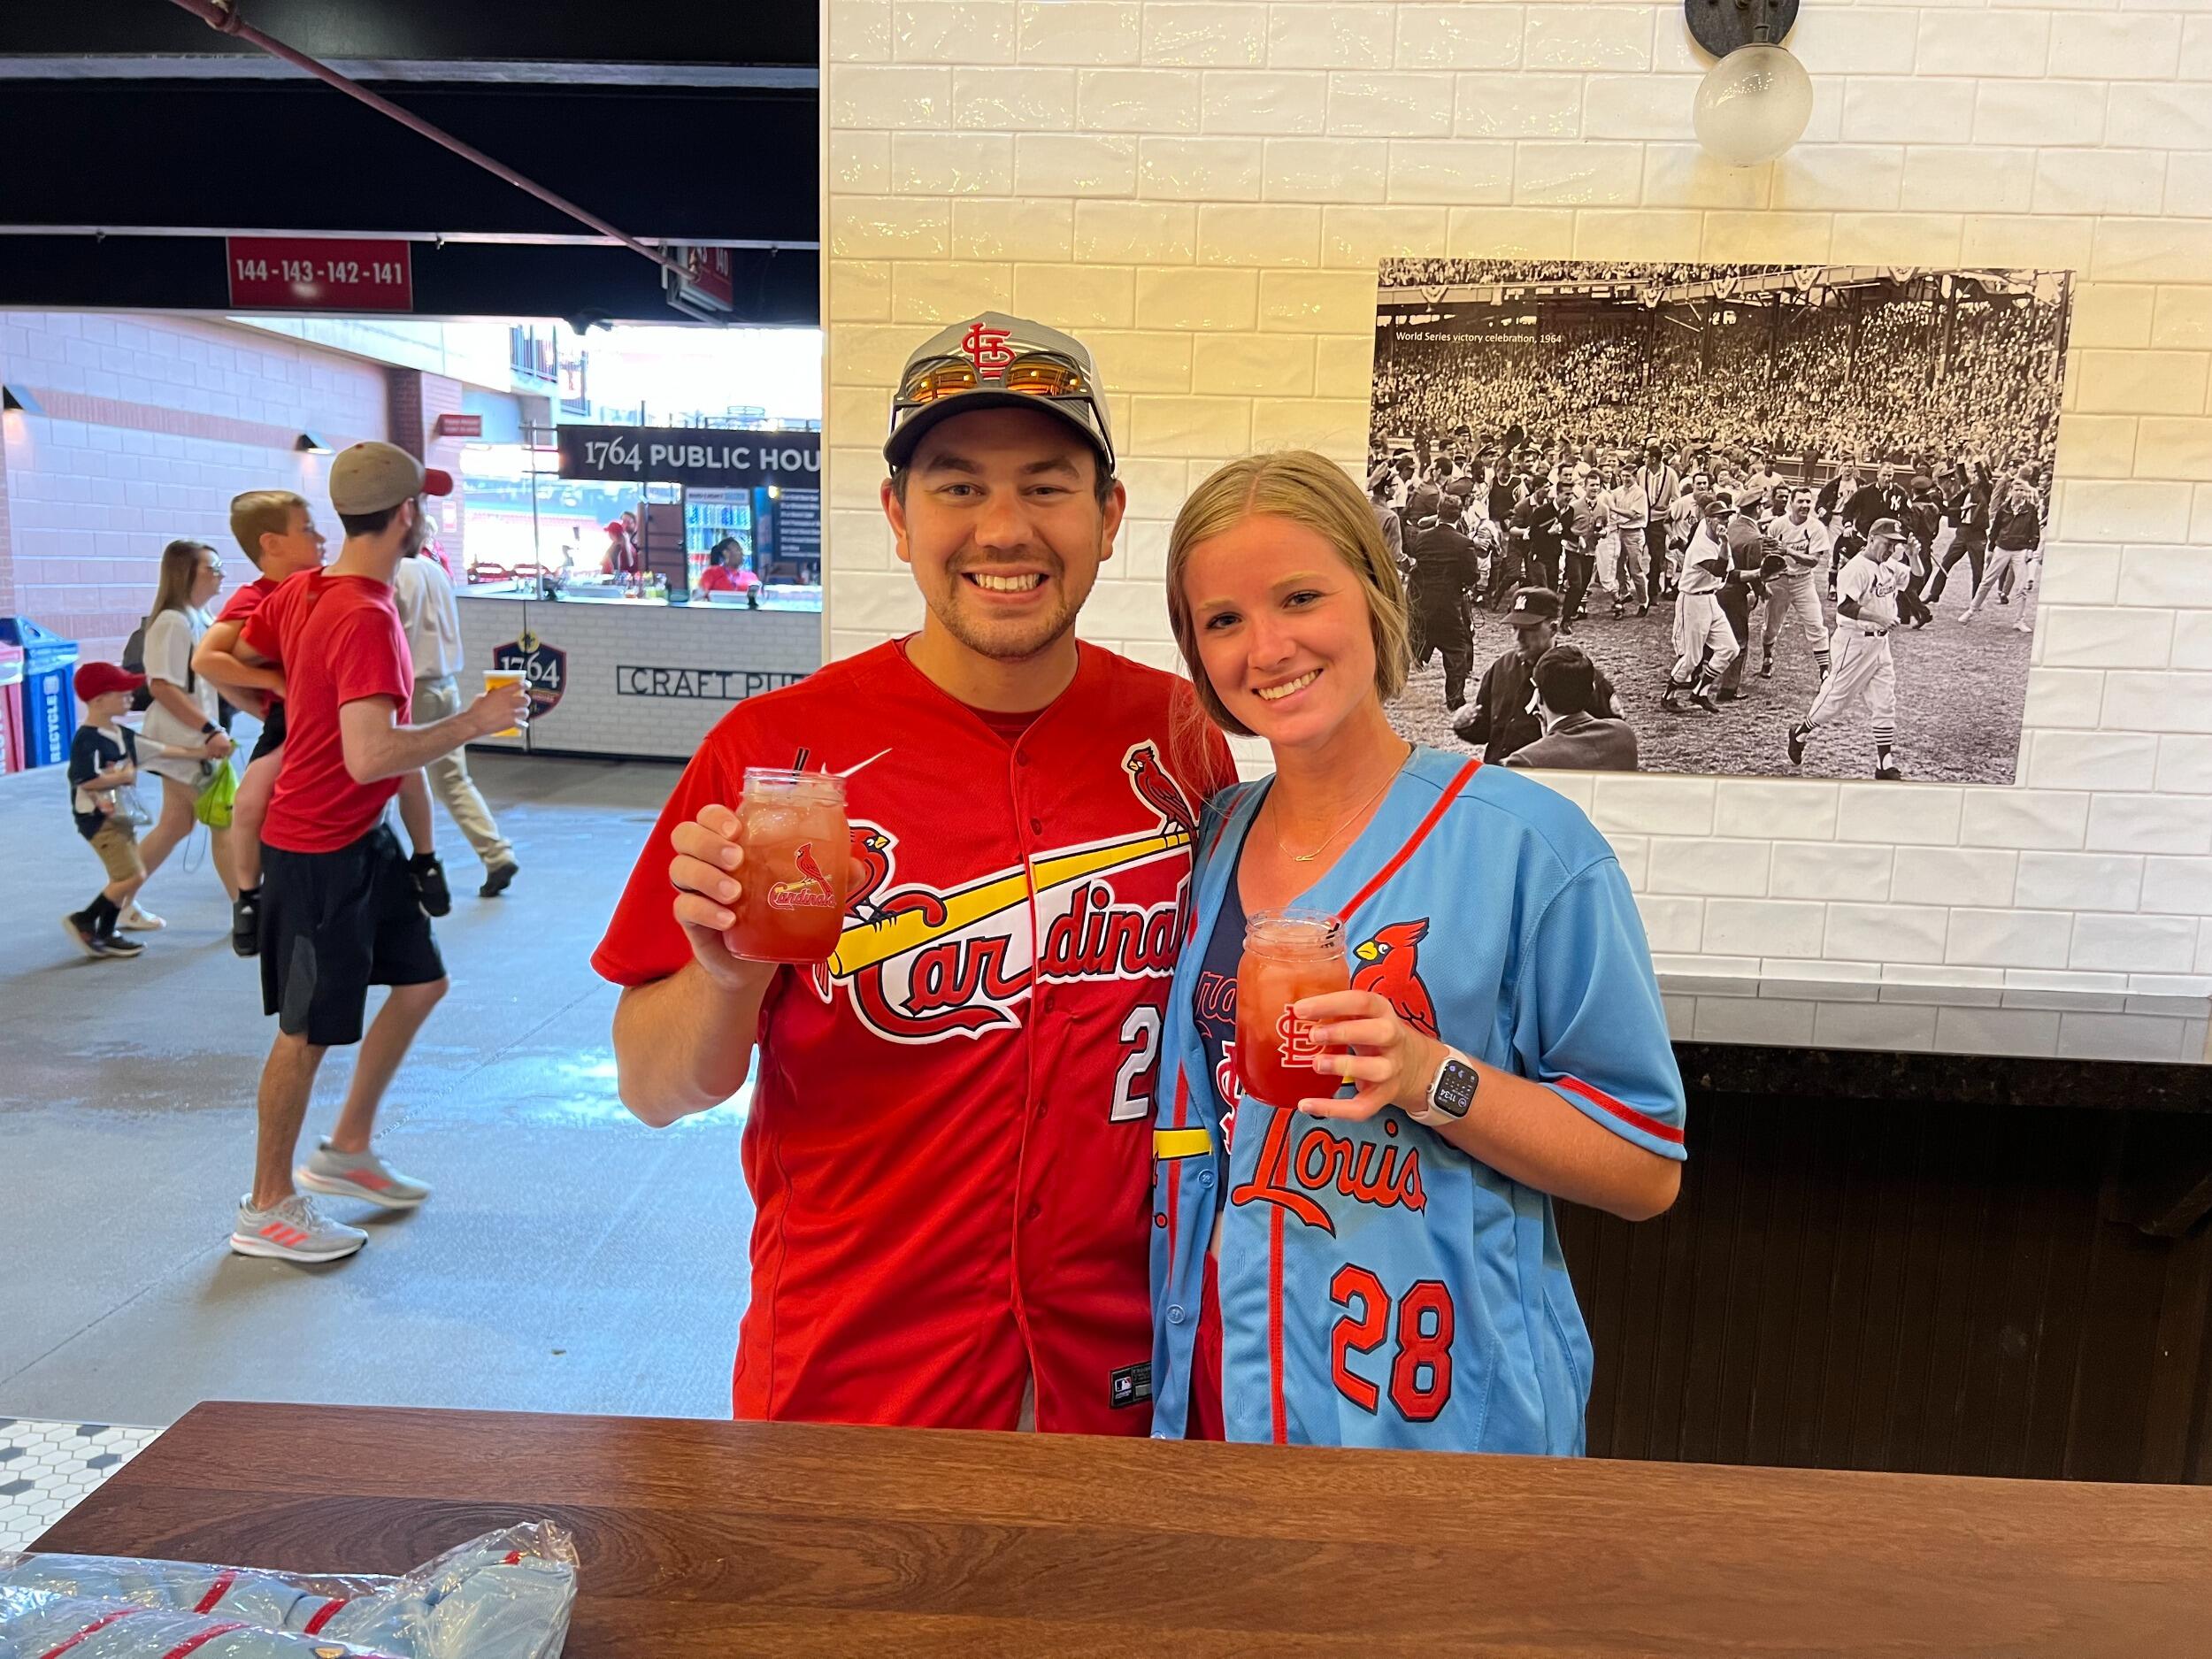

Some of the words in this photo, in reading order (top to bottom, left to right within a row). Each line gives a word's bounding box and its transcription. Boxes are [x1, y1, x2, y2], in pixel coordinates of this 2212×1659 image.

[1395, 332, 1423, 342] World
[1425, 333, 1451, 342] Series
[1453, 334, 1484, 343] victory
[1485, 334, 1538, 344] celebration,
[1540, 334, 1562, 343] 1964
[585, 436, 642, 472] 1764
[650, 444, 750, 469] PUBLIC
[760, 449, 821, 472] HOU
[631, 667, 733, 699] CRAFT
[46, 695, 61, 763] RECYCLE
[768, 881, 837, 910] Cardinals
[853, 878, 1193, 1042] Cardinal
[1232, 1106, 1428, 1240] Louis
[1330, 1263, 1455, 1422] 28
